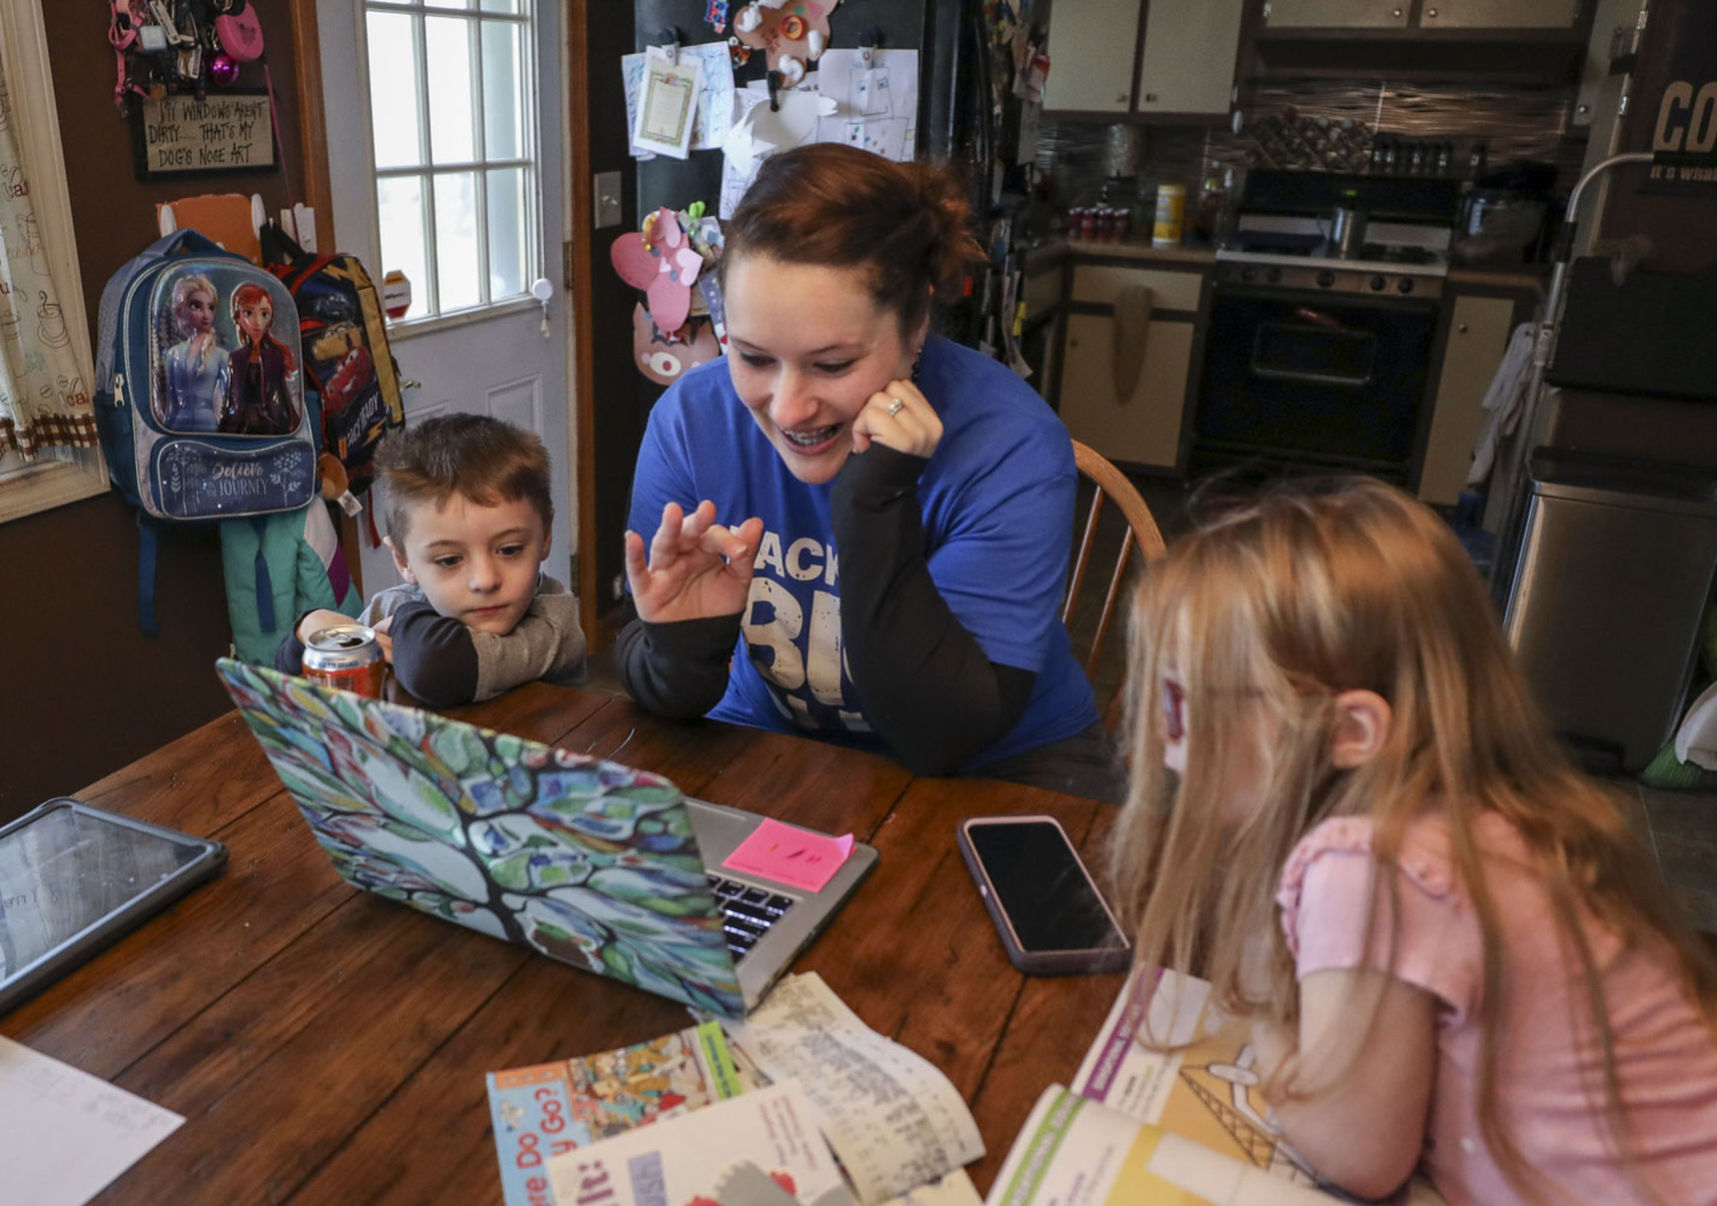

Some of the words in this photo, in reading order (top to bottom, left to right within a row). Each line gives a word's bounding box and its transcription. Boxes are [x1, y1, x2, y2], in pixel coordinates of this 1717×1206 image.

[159, 100, 177, 122] MY
[183, 101, 231, 121] WINDOWS
[200, 122, 235, 144] THAT'S
[239, 121, 255, 141] MY
[160, 147, 192, 168] DOG'S
[200, 144, 225, 165] NOSE
[231, 142, 252, 165] ART
[729, 525, 839, 586] ACK
[534, 1087, 566, 1134] Go?
[516, 1132, 543, 1170] Do
